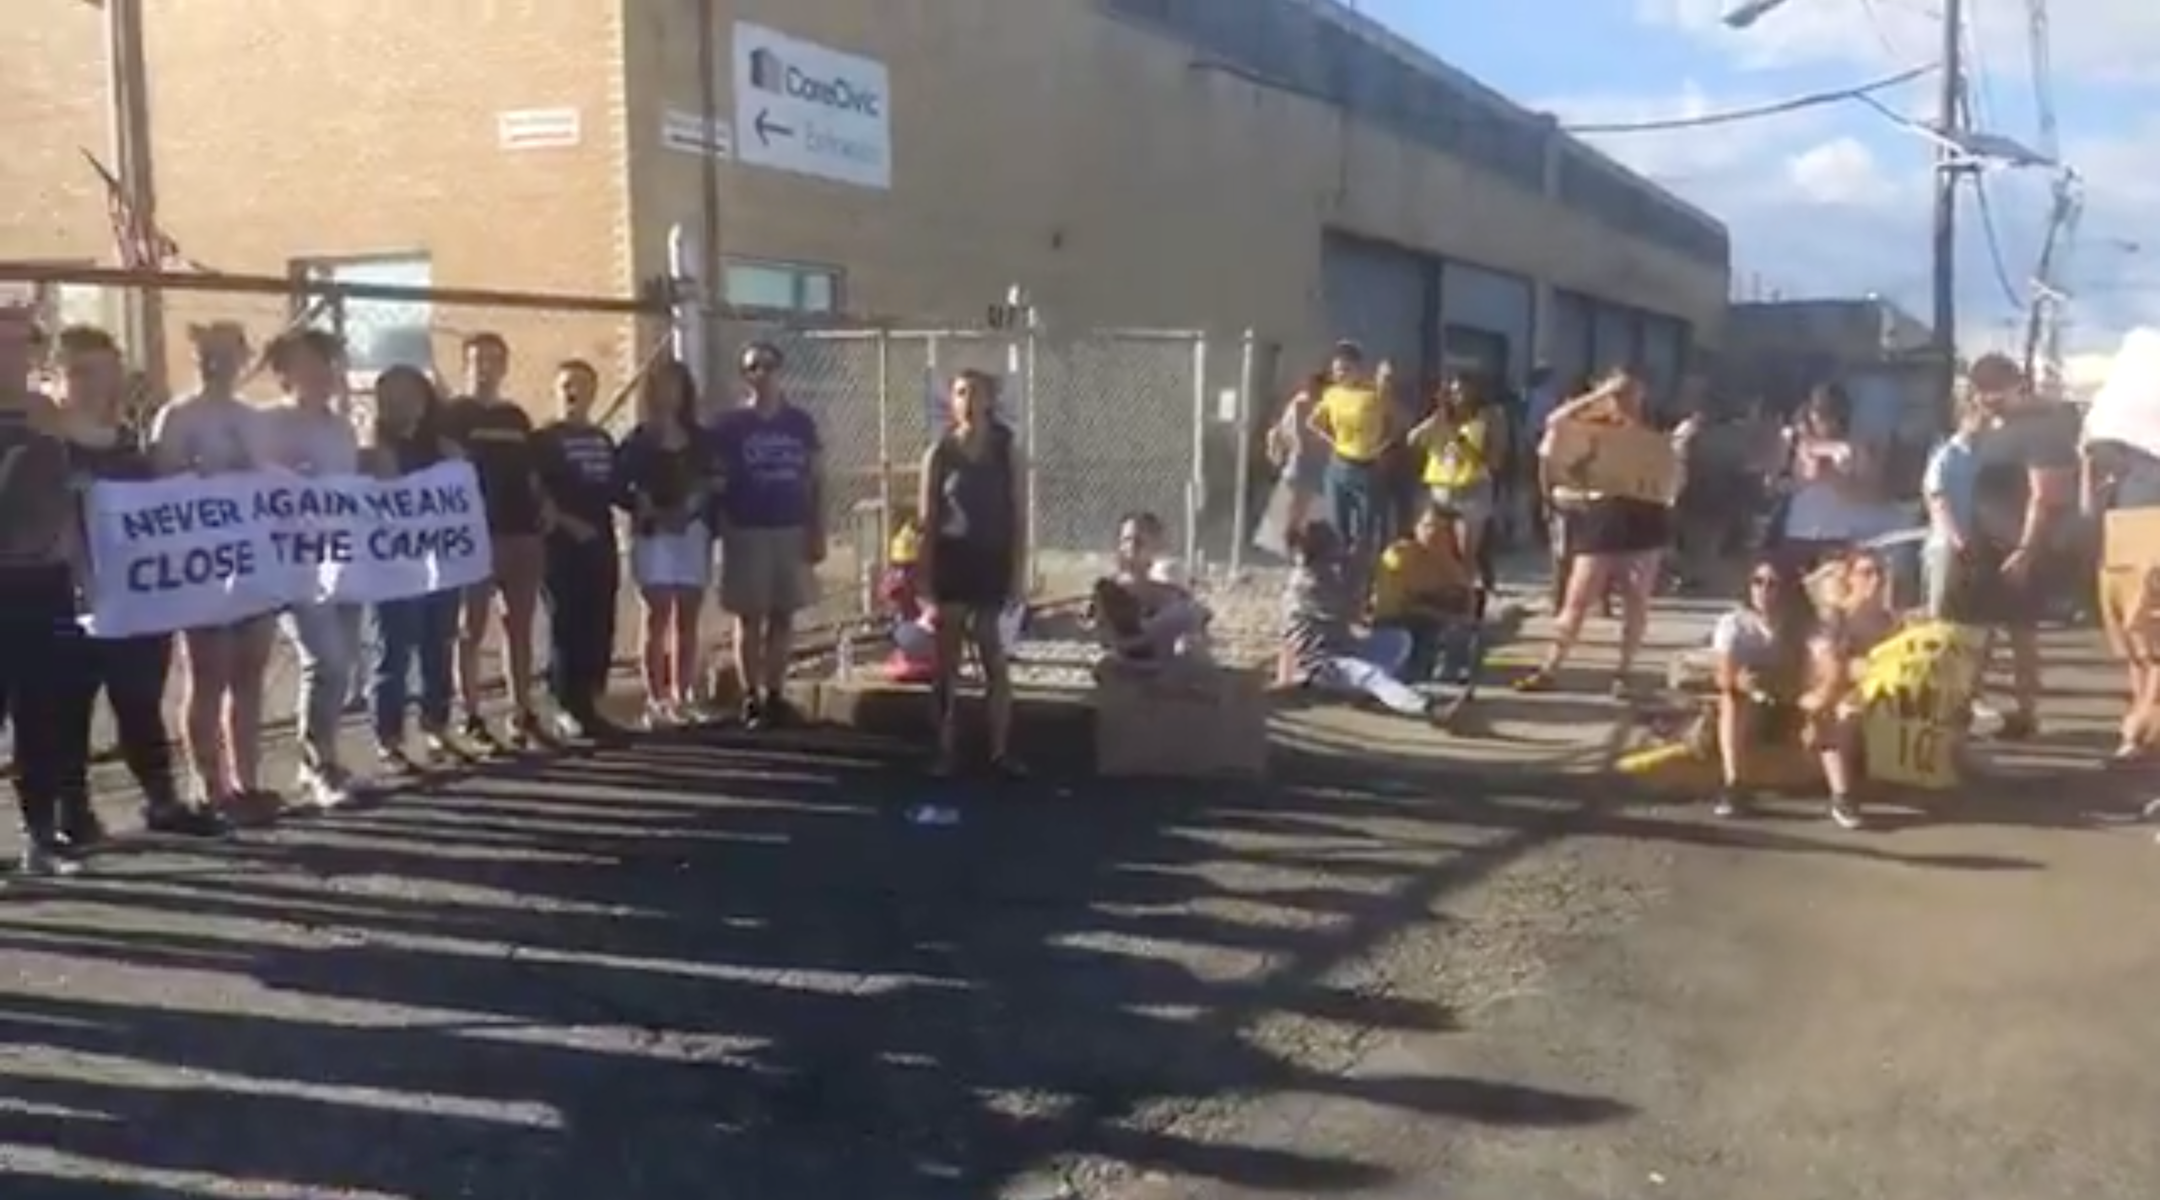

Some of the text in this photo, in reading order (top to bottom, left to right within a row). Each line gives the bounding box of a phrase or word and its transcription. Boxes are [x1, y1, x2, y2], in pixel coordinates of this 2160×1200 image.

[122, 484, 470, 540] NEVER AGAIN MEANS
[128, 525, 476, 592] CLOSE THE CAMPS
